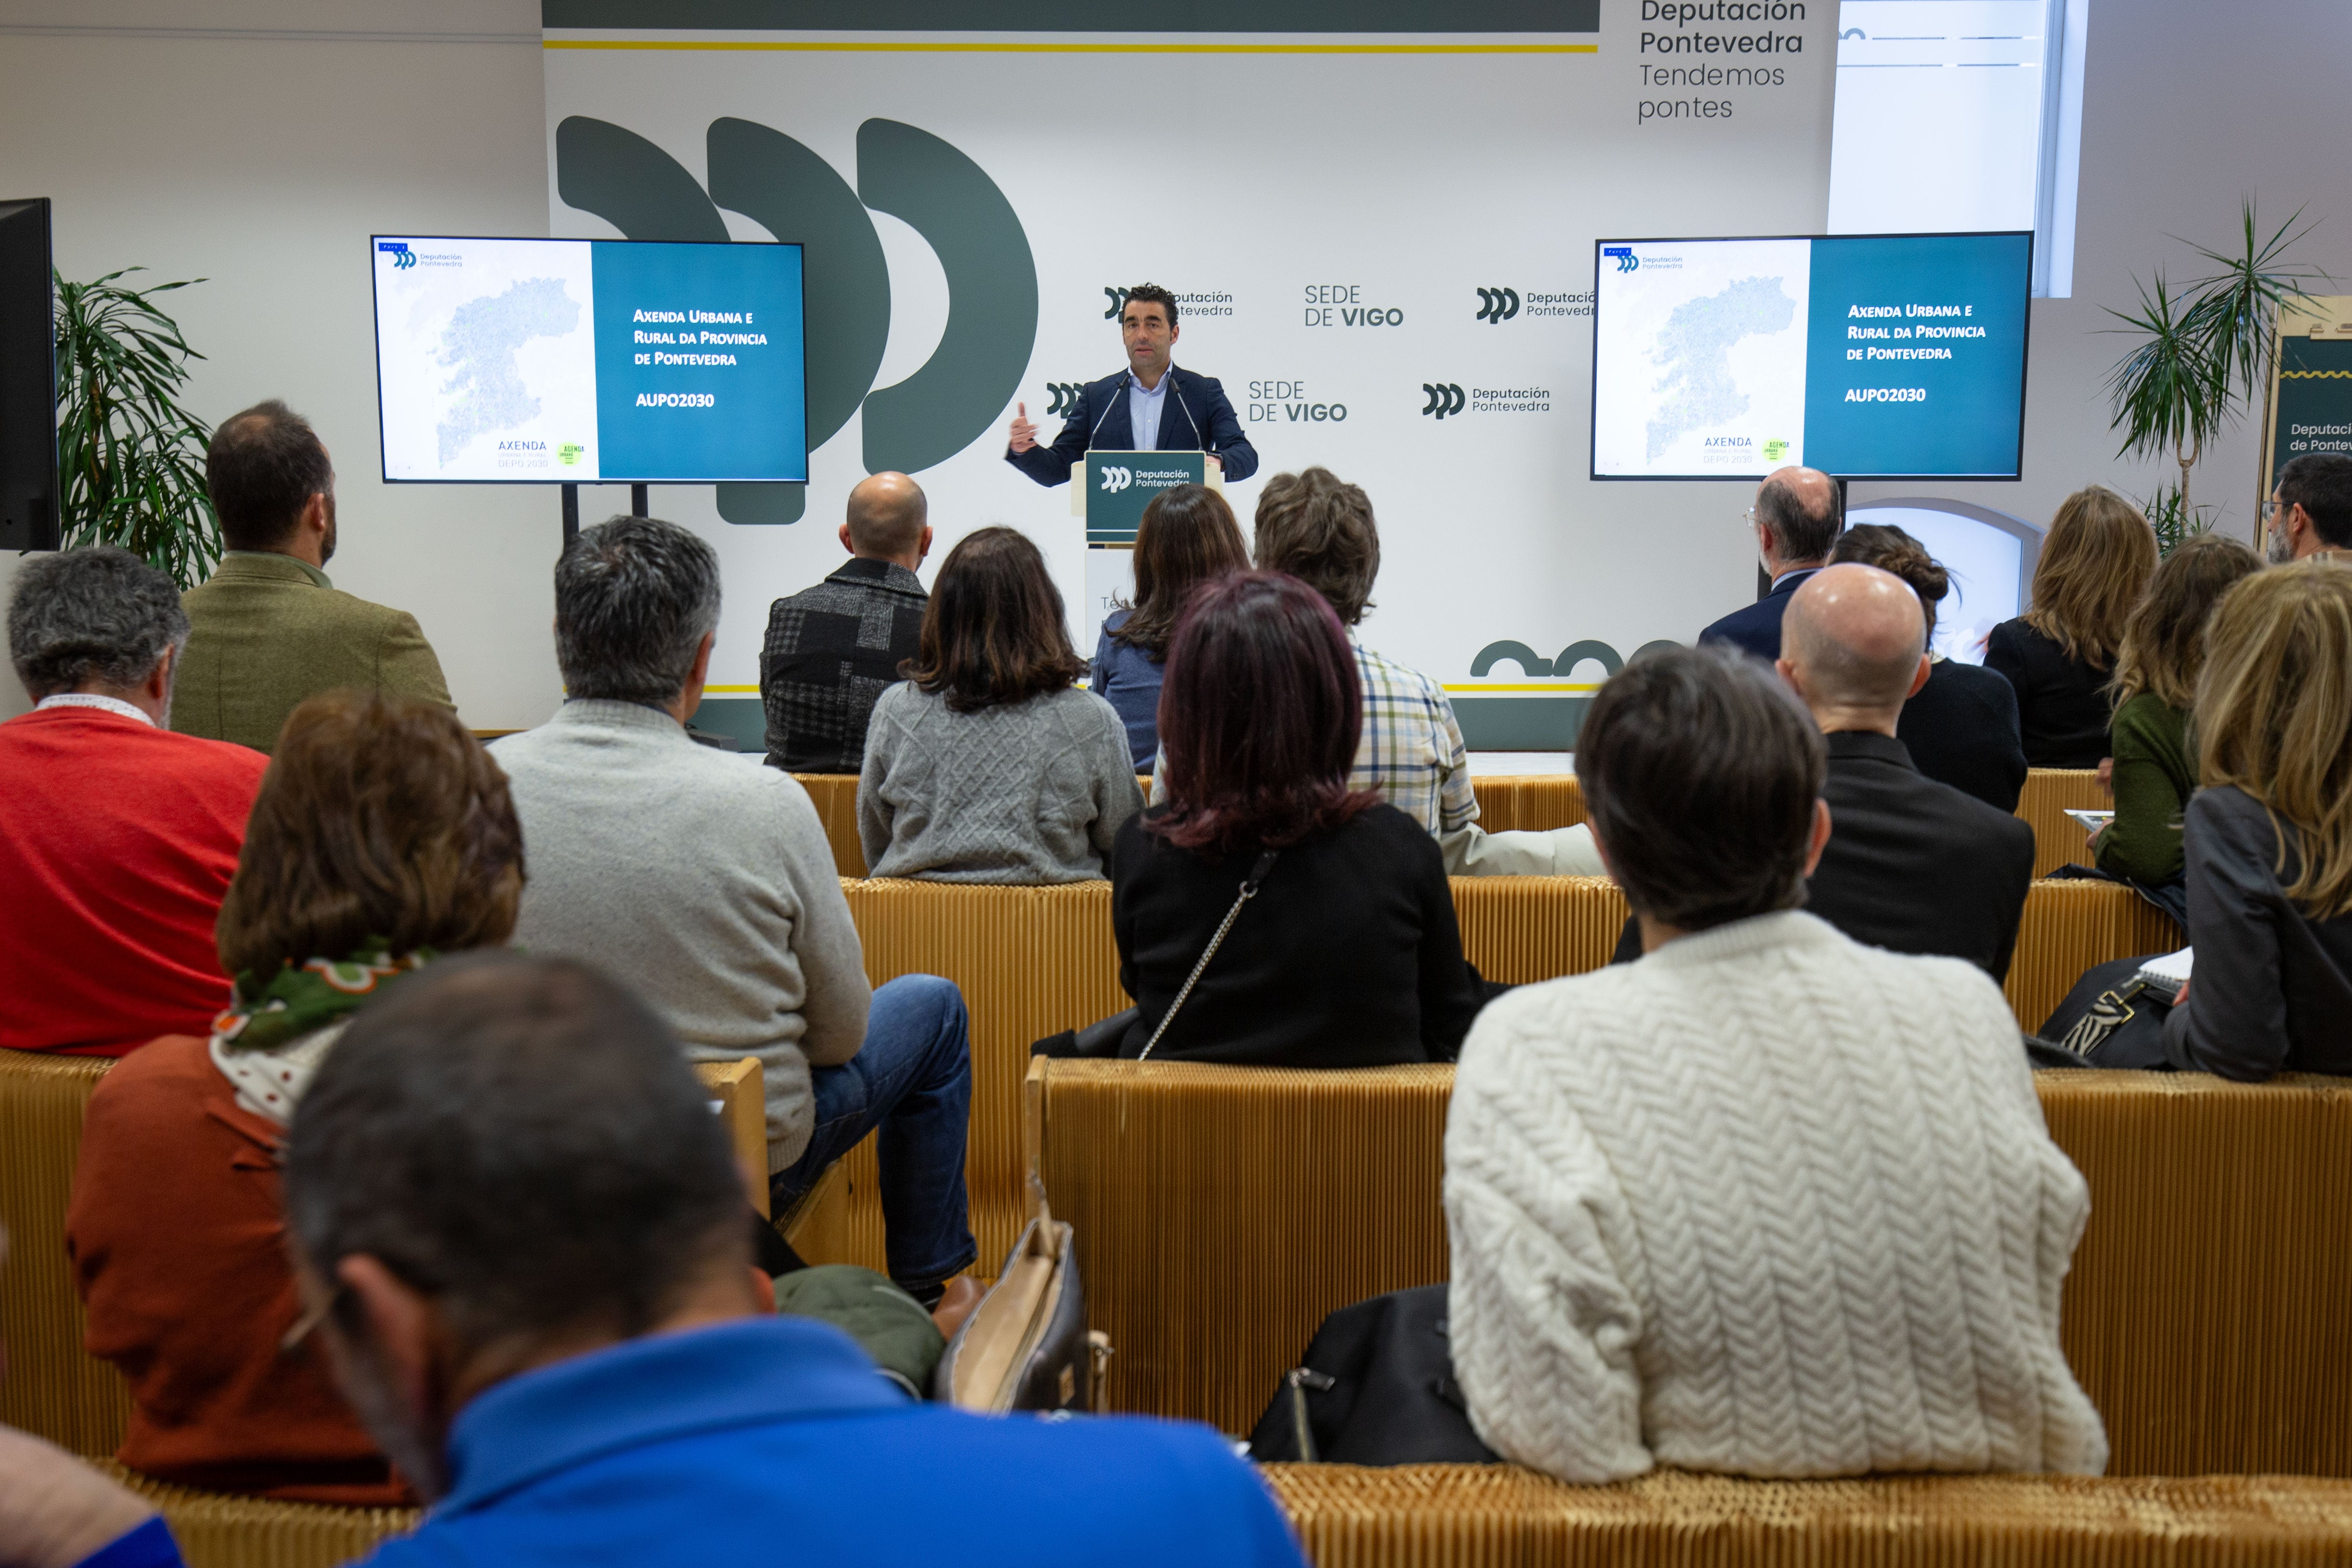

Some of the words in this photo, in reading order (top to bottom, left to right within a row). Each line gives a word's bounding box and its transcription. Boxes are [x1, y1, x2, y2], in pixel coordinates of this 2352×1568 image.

[1641, 0, 1805, 28] Deputación
[1641, 30, 1802, 53] Pontevedra
[1640, 63, 1784, 85] Tendemos
[1639, 97, 1732, 125] pontes
[1642, 256, 1683, 264] Deputación
[1174, 291, 1232, 303] putación
[1305, 285, 1360, 303] SEDE
[1527, 290, 1594, 306] Deputació
[1177, 305, 1232, 316] tevedra
[1305, 308, 1333, 326] DE
[1341, 308, 1404, 326] VIGO
[1249, 381, 1304, 399] SEDE
[1473, 386, 1550, 401] Deputación
[1844, 388, 1926, 402] AUPO2030
[636, 393, 714, 408] AUPO2030
[1473, 400, 1549, 411] Pontevedra
[1250, 404, 1277, 422] DE
[1285, 403, 1347, 422] VIGO
[2291, 423, 2352, 438] Deputaci
[498, 441, 546, 450] AXENDA
[1705, 437, 1752, 446] AXENDA
[2290, 439, 2307, 451] de
[1136, 469, 1189, 481] Deputación
